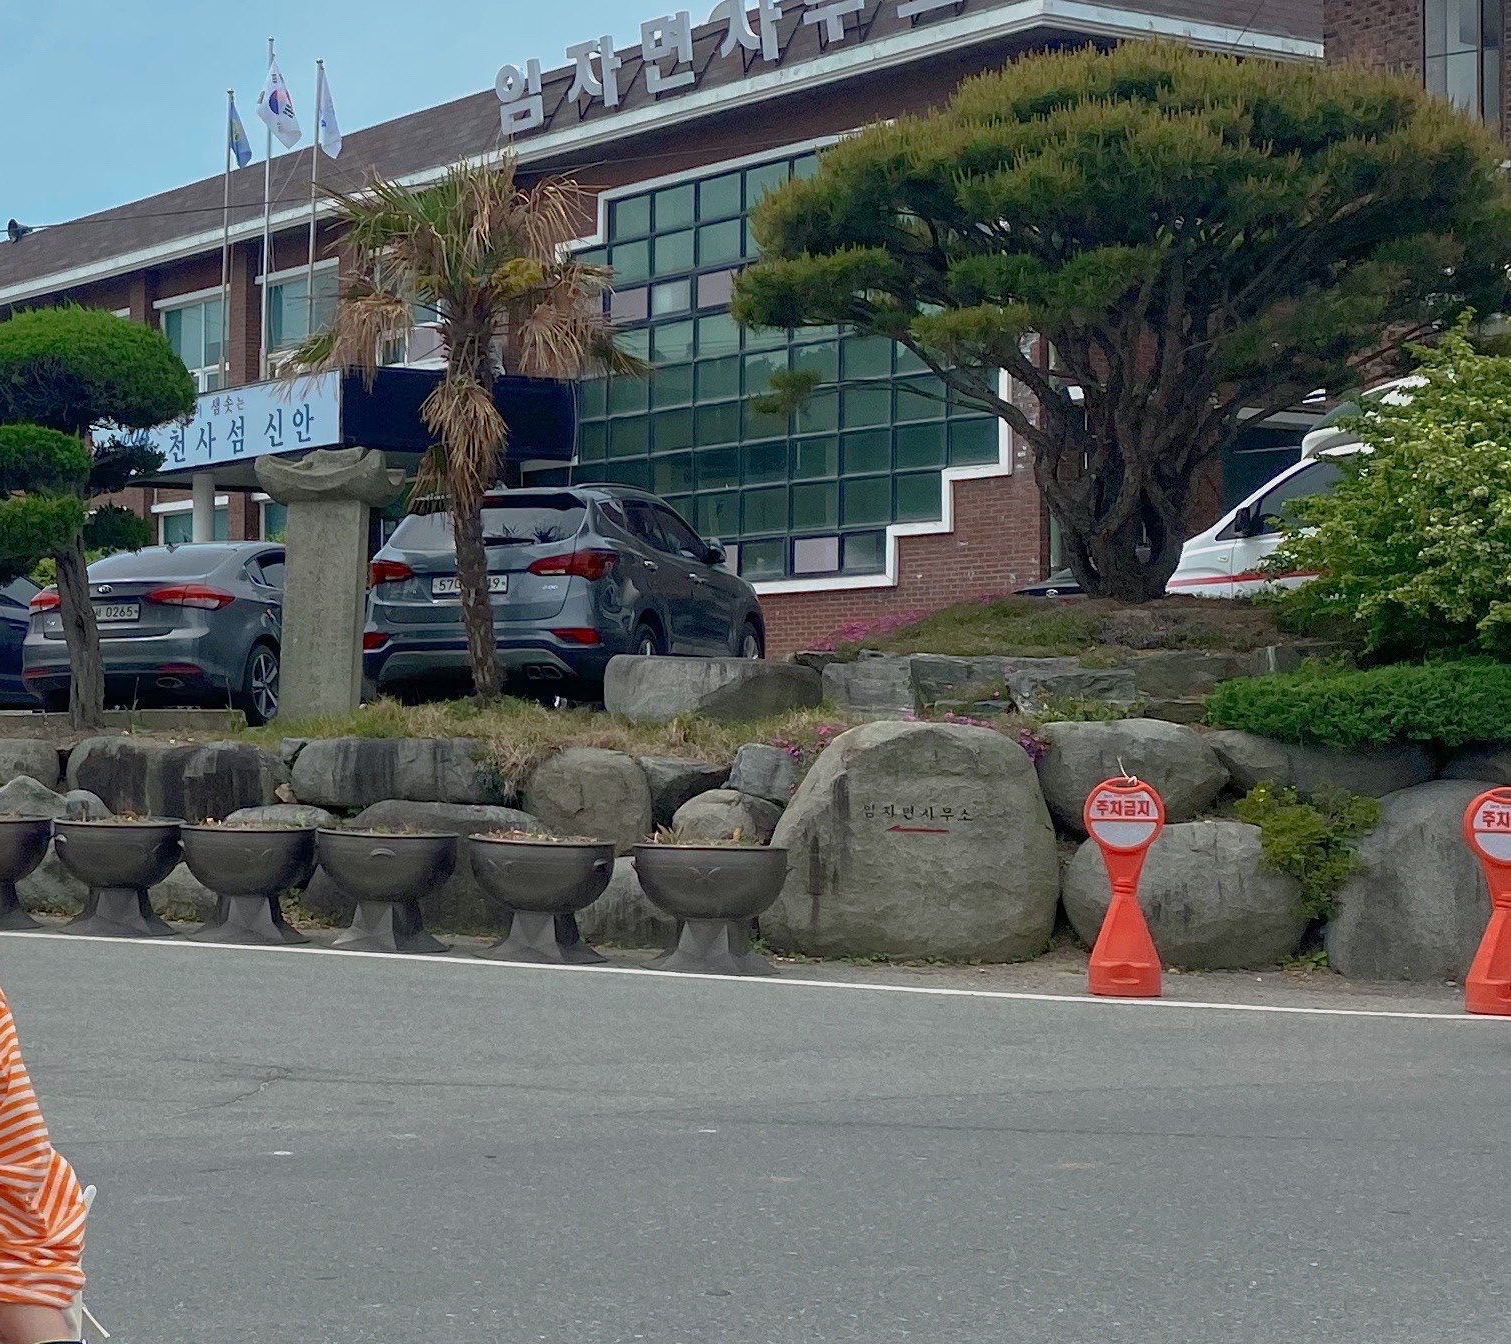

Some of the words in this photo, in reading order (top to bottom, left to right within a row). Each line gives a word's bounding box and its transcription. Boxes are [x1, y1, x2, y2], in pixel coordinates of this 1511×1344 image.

[211, 395, 245, 416] 샘솟는
[169, 416, 246, 463] 천사섬
[264, 403, 315, 448] 신안
[105, 606, 133, 618] 0265
[1096, 799, 1150, 816] 주차금지
